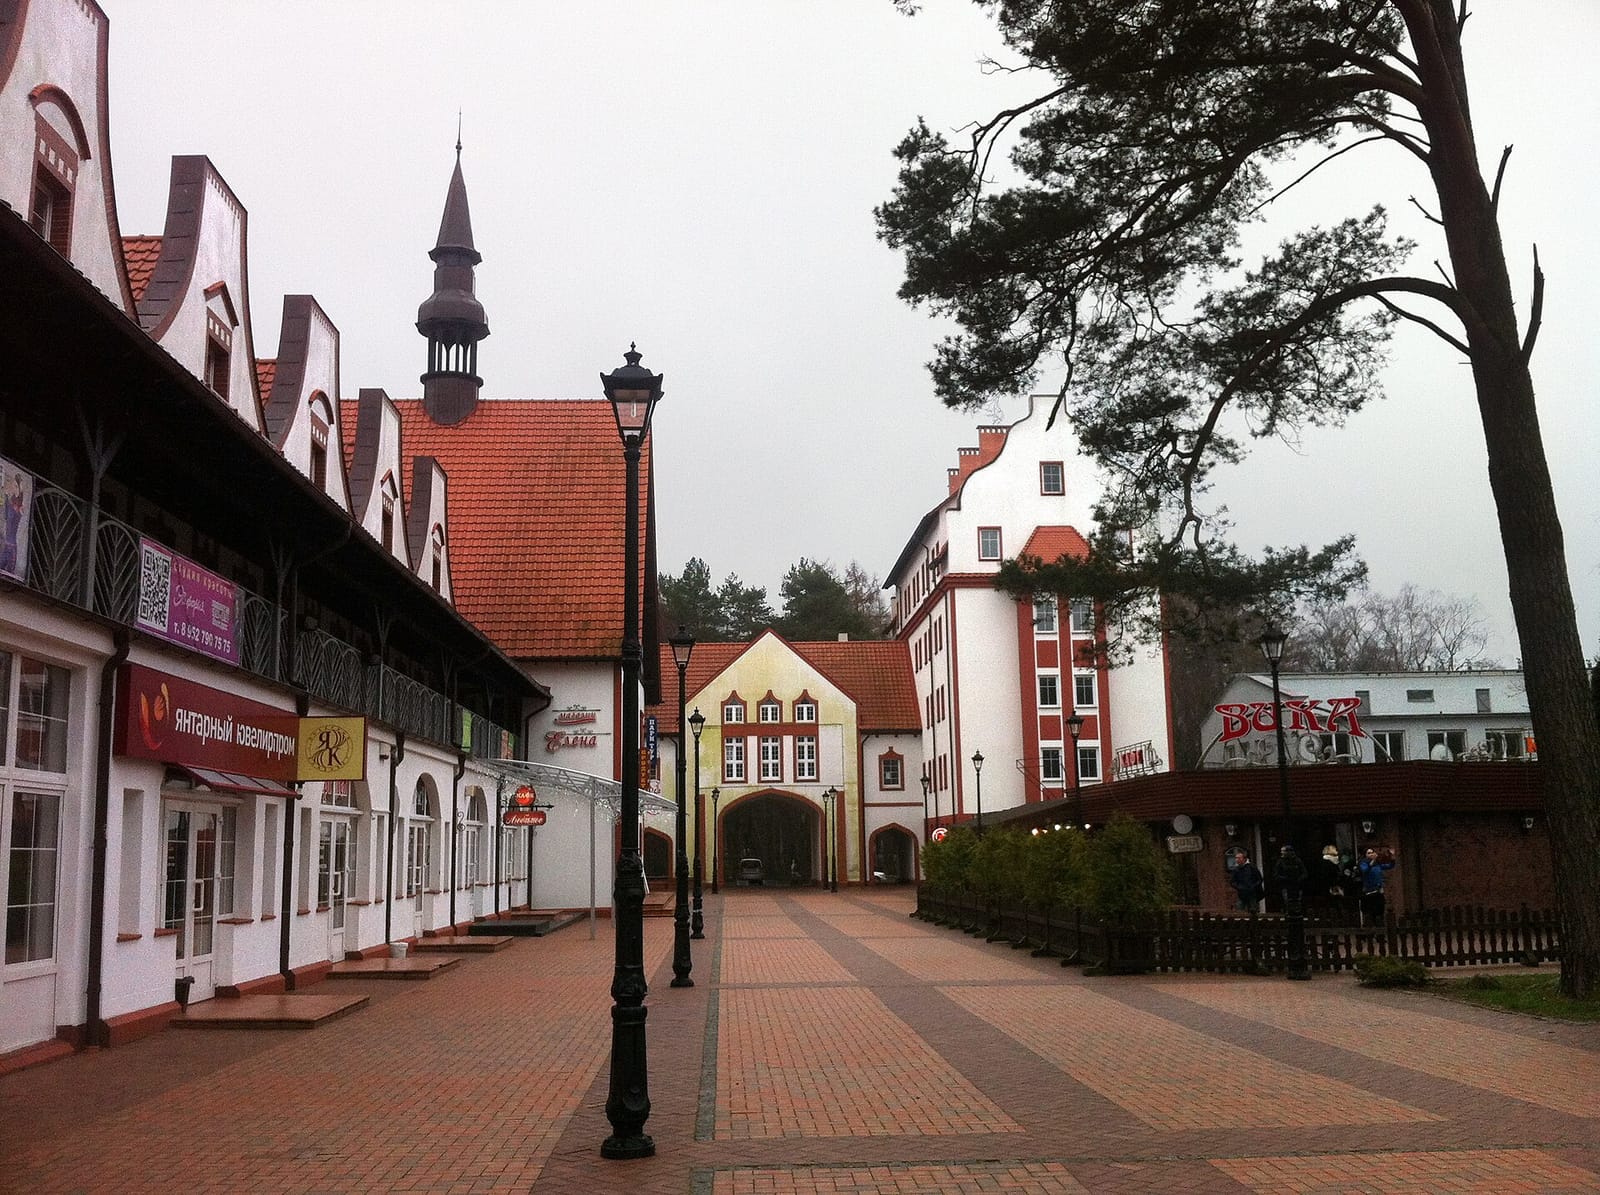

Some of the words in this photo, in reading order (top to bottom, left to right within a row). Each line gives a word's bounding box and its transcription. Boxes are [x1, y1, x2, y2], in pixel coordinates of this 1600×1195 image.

[181, 622, 186, 636] 8
[187, 625, 200, 641] 952
[201, 631, 213, 646] 790
[214, 635, 222, 650] 75
[223, 639, 231, 654] 75
